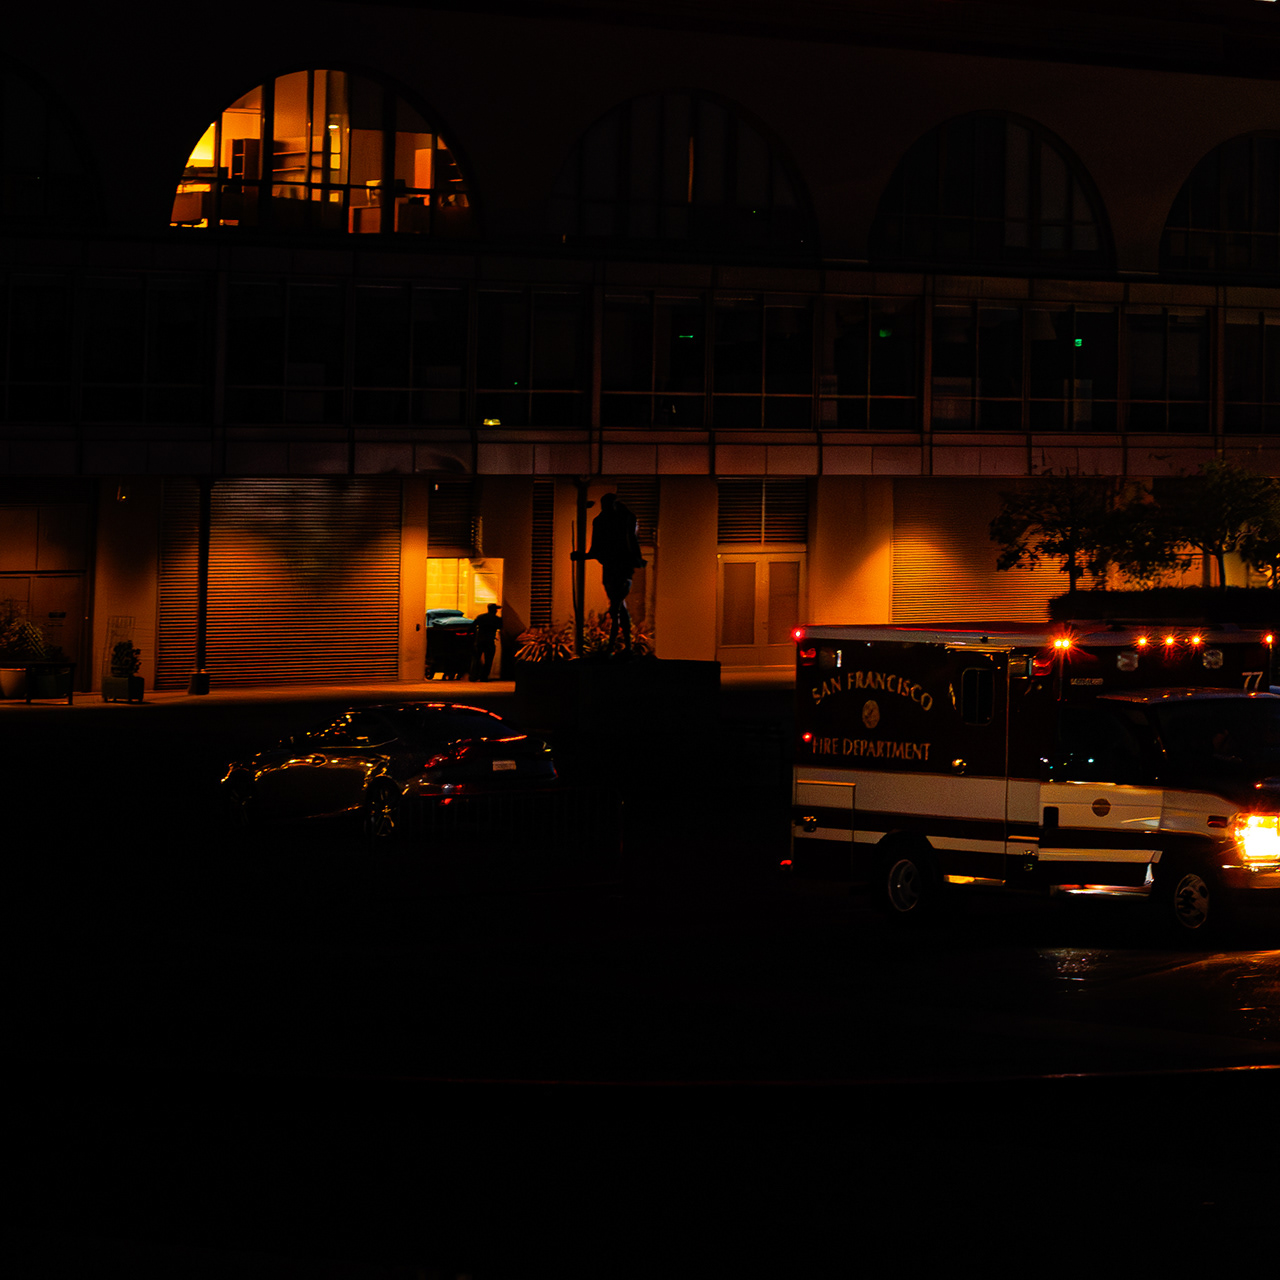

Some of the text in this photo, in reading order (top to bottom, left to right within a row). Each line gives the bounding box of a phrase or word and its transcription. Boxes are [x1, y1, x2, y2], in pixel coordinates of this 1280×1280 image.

[811, 670, 934, 711] SAN FRANCISCO
[1241, 670, 1264, 692] 77
[812, 736, 932, 761] FIRE DEPARTMENT
